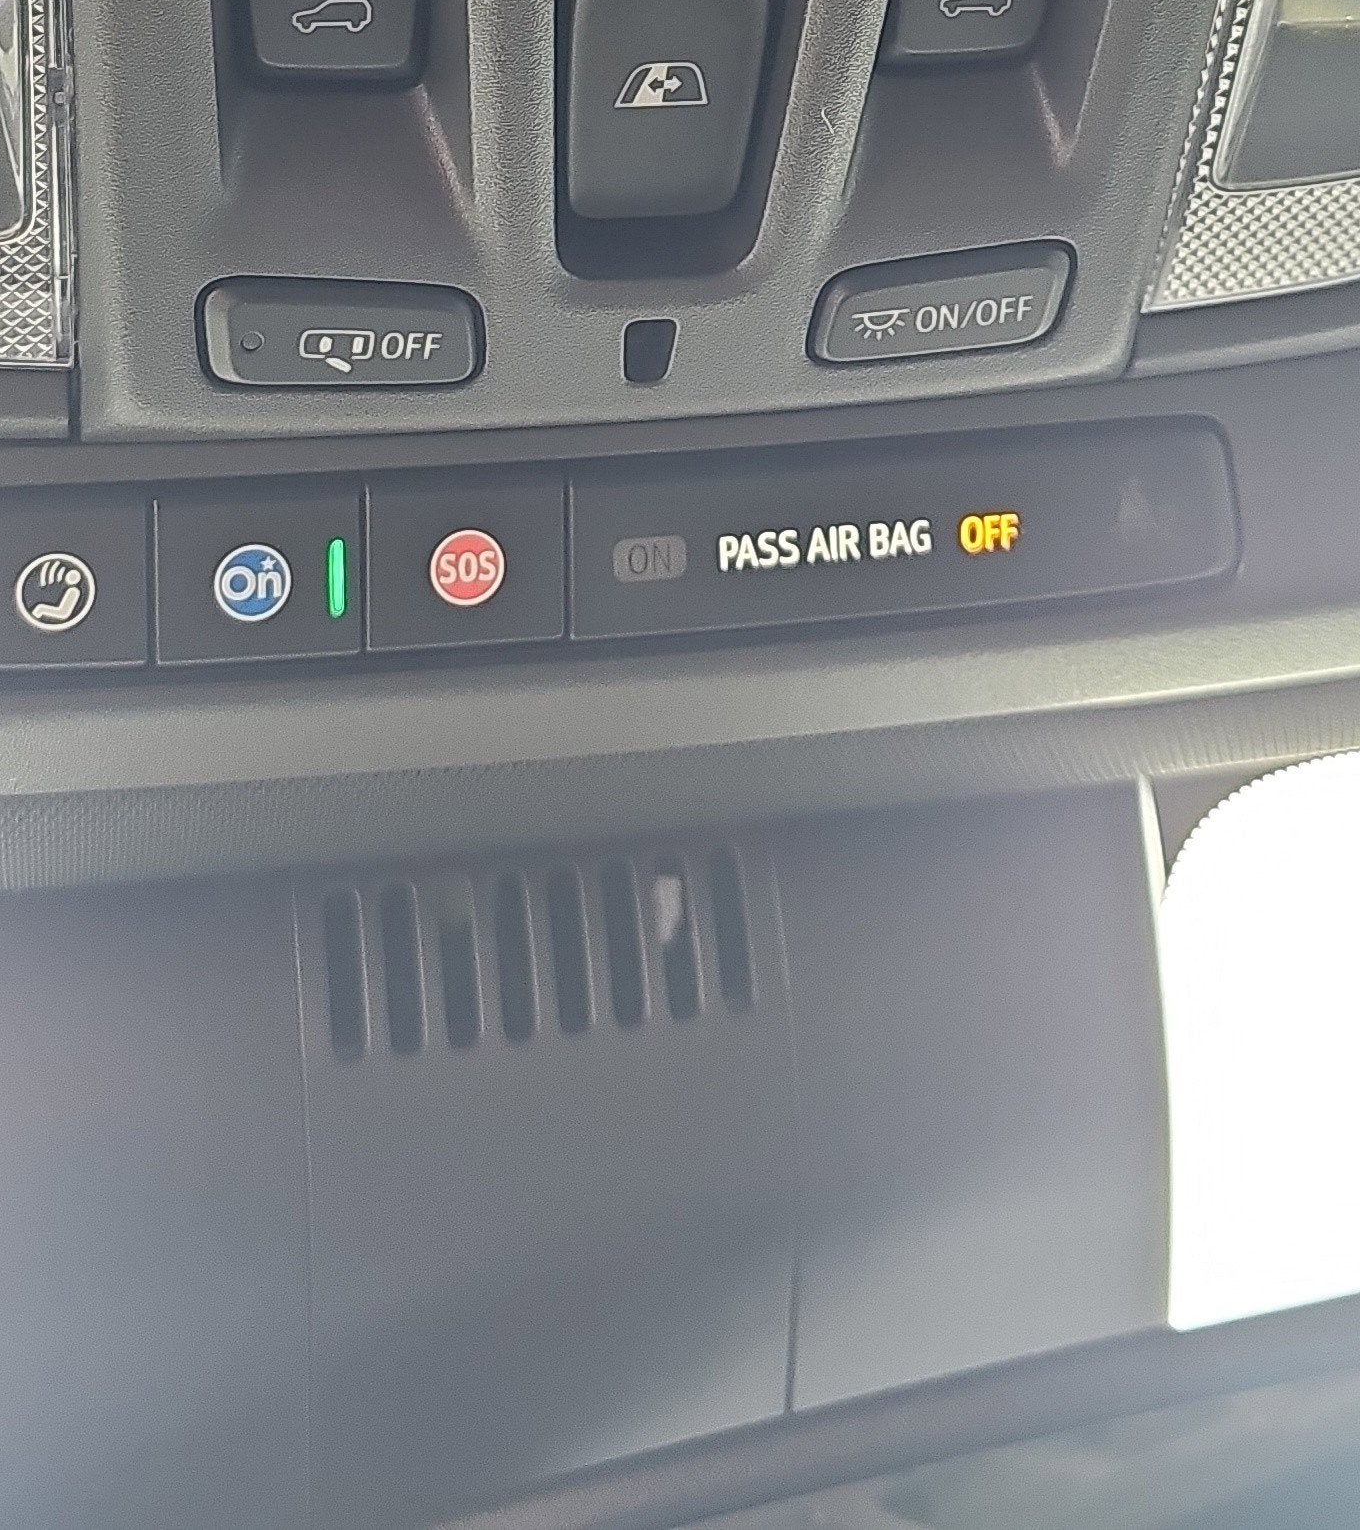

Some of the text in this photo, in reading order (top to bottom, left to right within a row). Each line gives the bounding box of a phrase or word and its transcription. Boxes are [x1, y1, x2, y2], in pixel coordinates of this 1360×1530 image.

[914, 295, 1034, 334] ON/OFF
[380, 330, 443, 361] OFF
[626, 512, 1020, 574] ON PASS AIR BAG OFF
[220, 566, 282, 602] On
[438, 549, 498, 584] SOS
